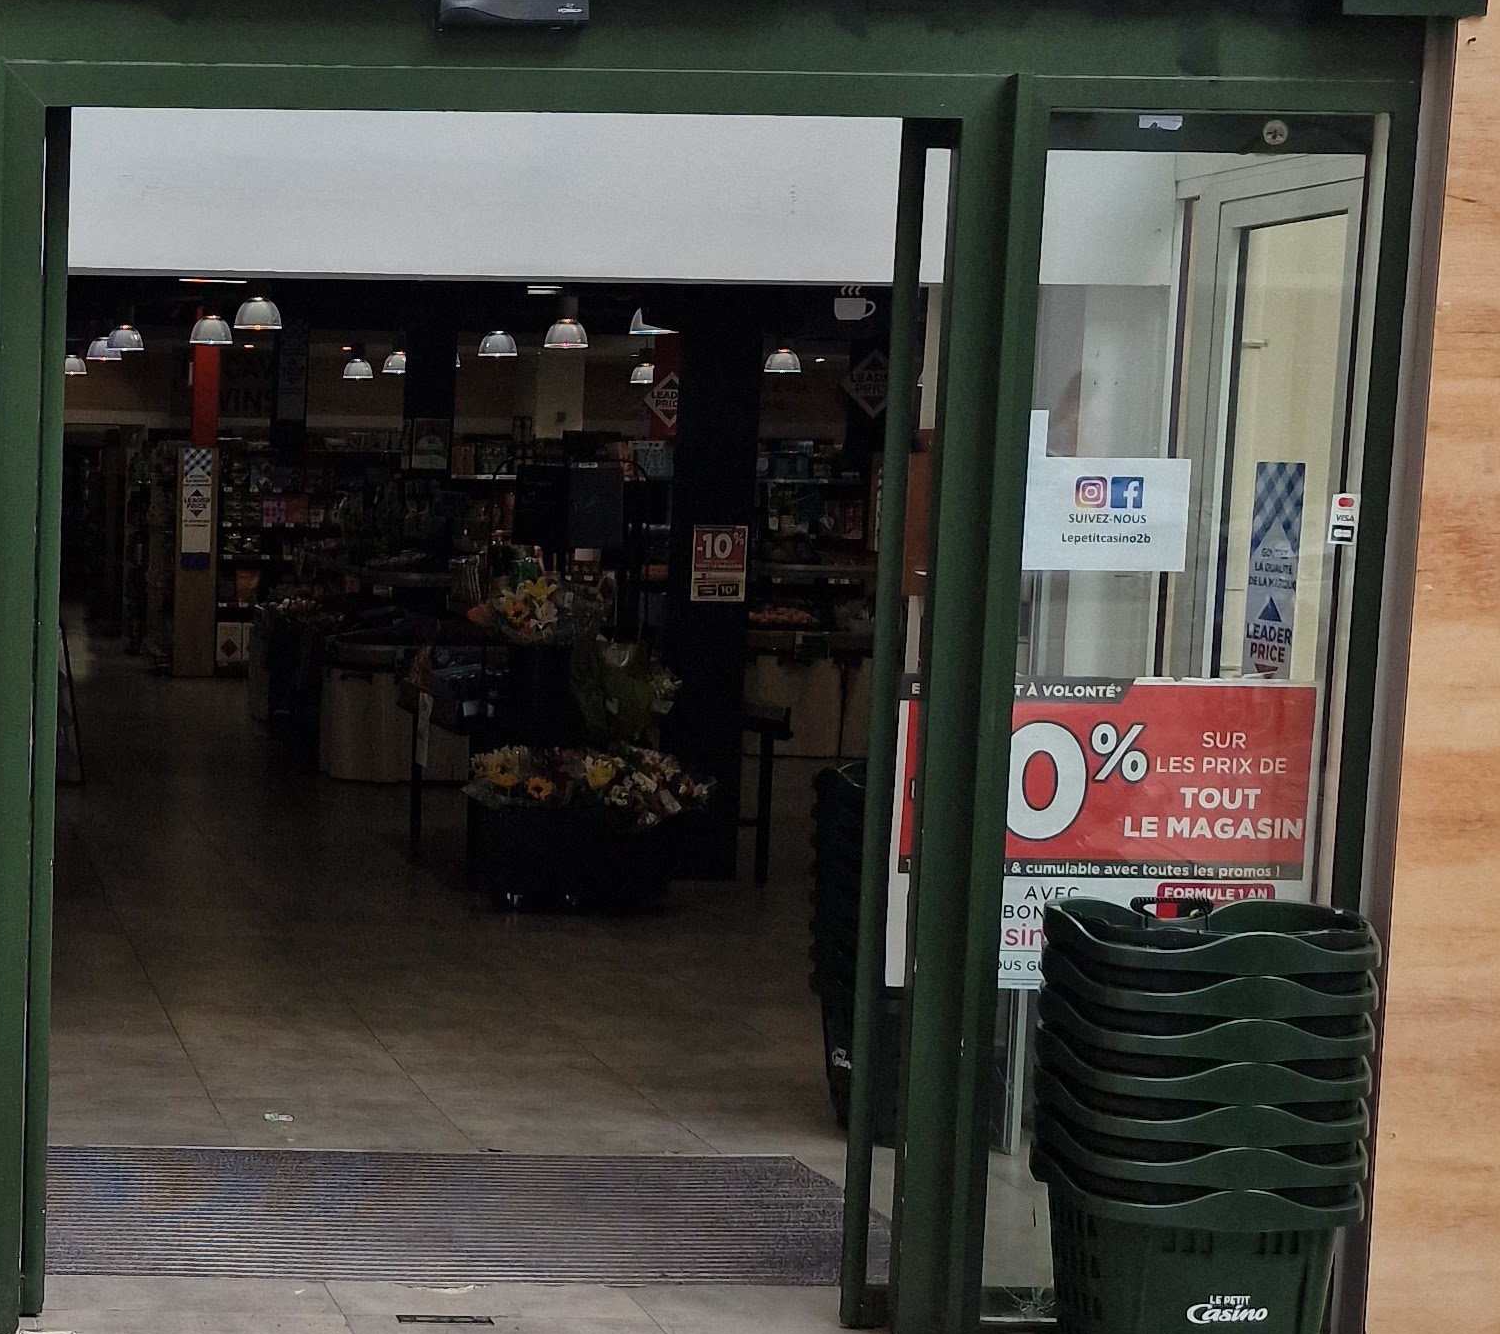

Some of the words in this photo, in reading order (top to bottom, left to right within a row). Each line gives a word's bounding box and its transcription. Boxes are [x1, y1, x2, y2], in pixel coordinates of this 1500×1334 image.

[651, 391, 678, 399] LEAD
[655, 399, 678, 408] PRIC
[1068, 513, 1147, 524] SUIVEZ-NOUS
[1336, 514, 1355, 522] VISA
[696, 531, 745, 559] -10%
[1061, 532, 1152, 545] Lepetitcasino2b
[1246, 623, 1293, 646] LEADER
[1250, 642, 1286, 663] PRICE
[1026, 682, 1038, 697] À
[1202, 731, 1247, 749] SUR
[1156, 756, 1195, 773] LES
[1202, 757, 1252, 774] PRIX
[1259, 757, 1288, 774] DE
[1007, 722, 1149, 840] 0%
[1180, 787, 1261, 810] TOUT
[1123, 815, 1159, 838] LE
[1167, 816, 1303, 840] MAGASIN
[1011, 862, 1021, 874] &
[1025, 862, 1100, 876] cumulable
[1103, 865, 1138, 877] avec
[1142, 863, 1189, 877] toutes
[1193, 863, 1215, 877] les
[1218, 866, 1272, 879] promos
[1163, 886, 1236, 900] FORMULE
[1247, 887, 1269, 899] AN
[1004, 922, 1046, 946] sin
[1209, 1295, 1222, 1304] LE
[1223, 1295, 1251, 1306] PETIT
[1187, 1304, 1268, 1324] Casino
